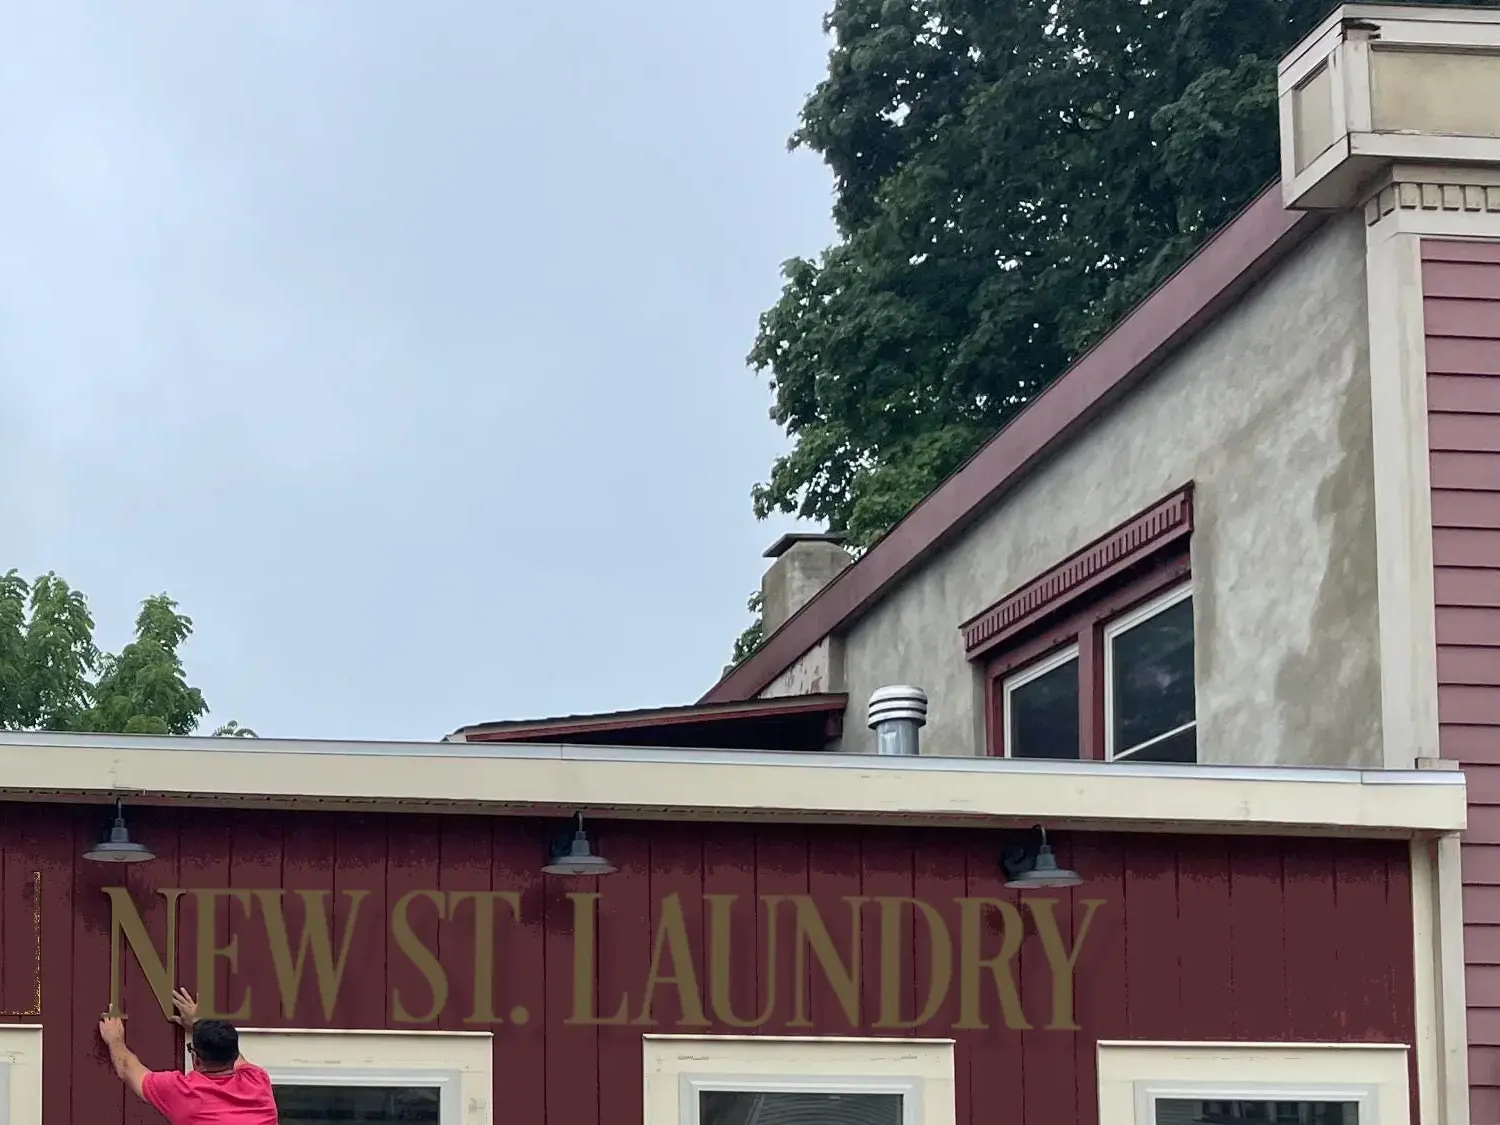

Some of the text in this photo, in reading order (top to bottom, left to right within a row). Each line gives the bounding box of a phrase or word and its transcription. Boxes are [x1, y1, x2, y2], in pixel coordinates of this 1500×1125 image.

[102, 886, 1107, 1031] NEW ST. LAUNDRY
